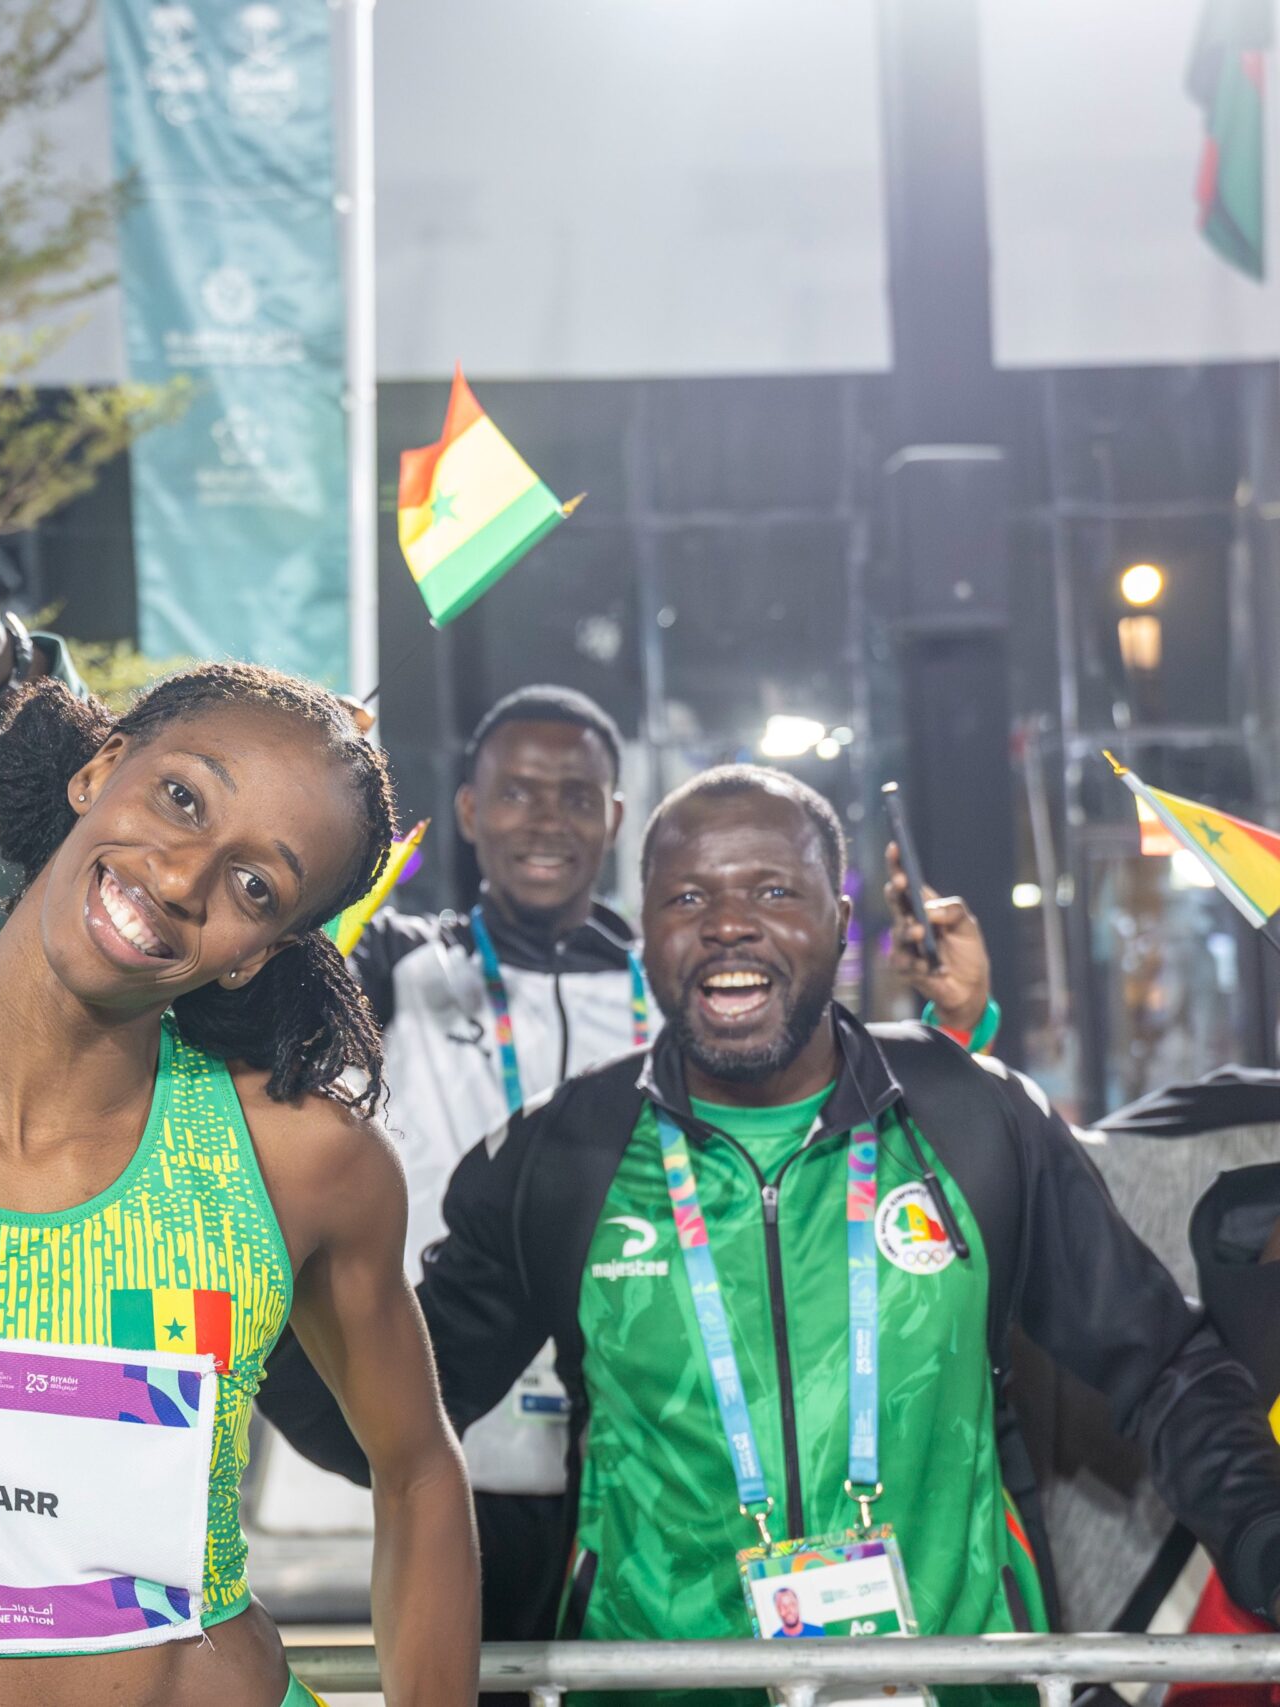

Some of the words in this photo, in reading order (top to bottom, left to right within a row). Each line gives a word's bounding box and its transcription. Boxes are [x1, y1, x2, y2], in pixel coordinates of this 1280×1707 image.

[591, 1258, 669, 1282] majestee
[50, 1375, 79, 1385] RIYADH
[13, 1614, 54, 1626] NATION
